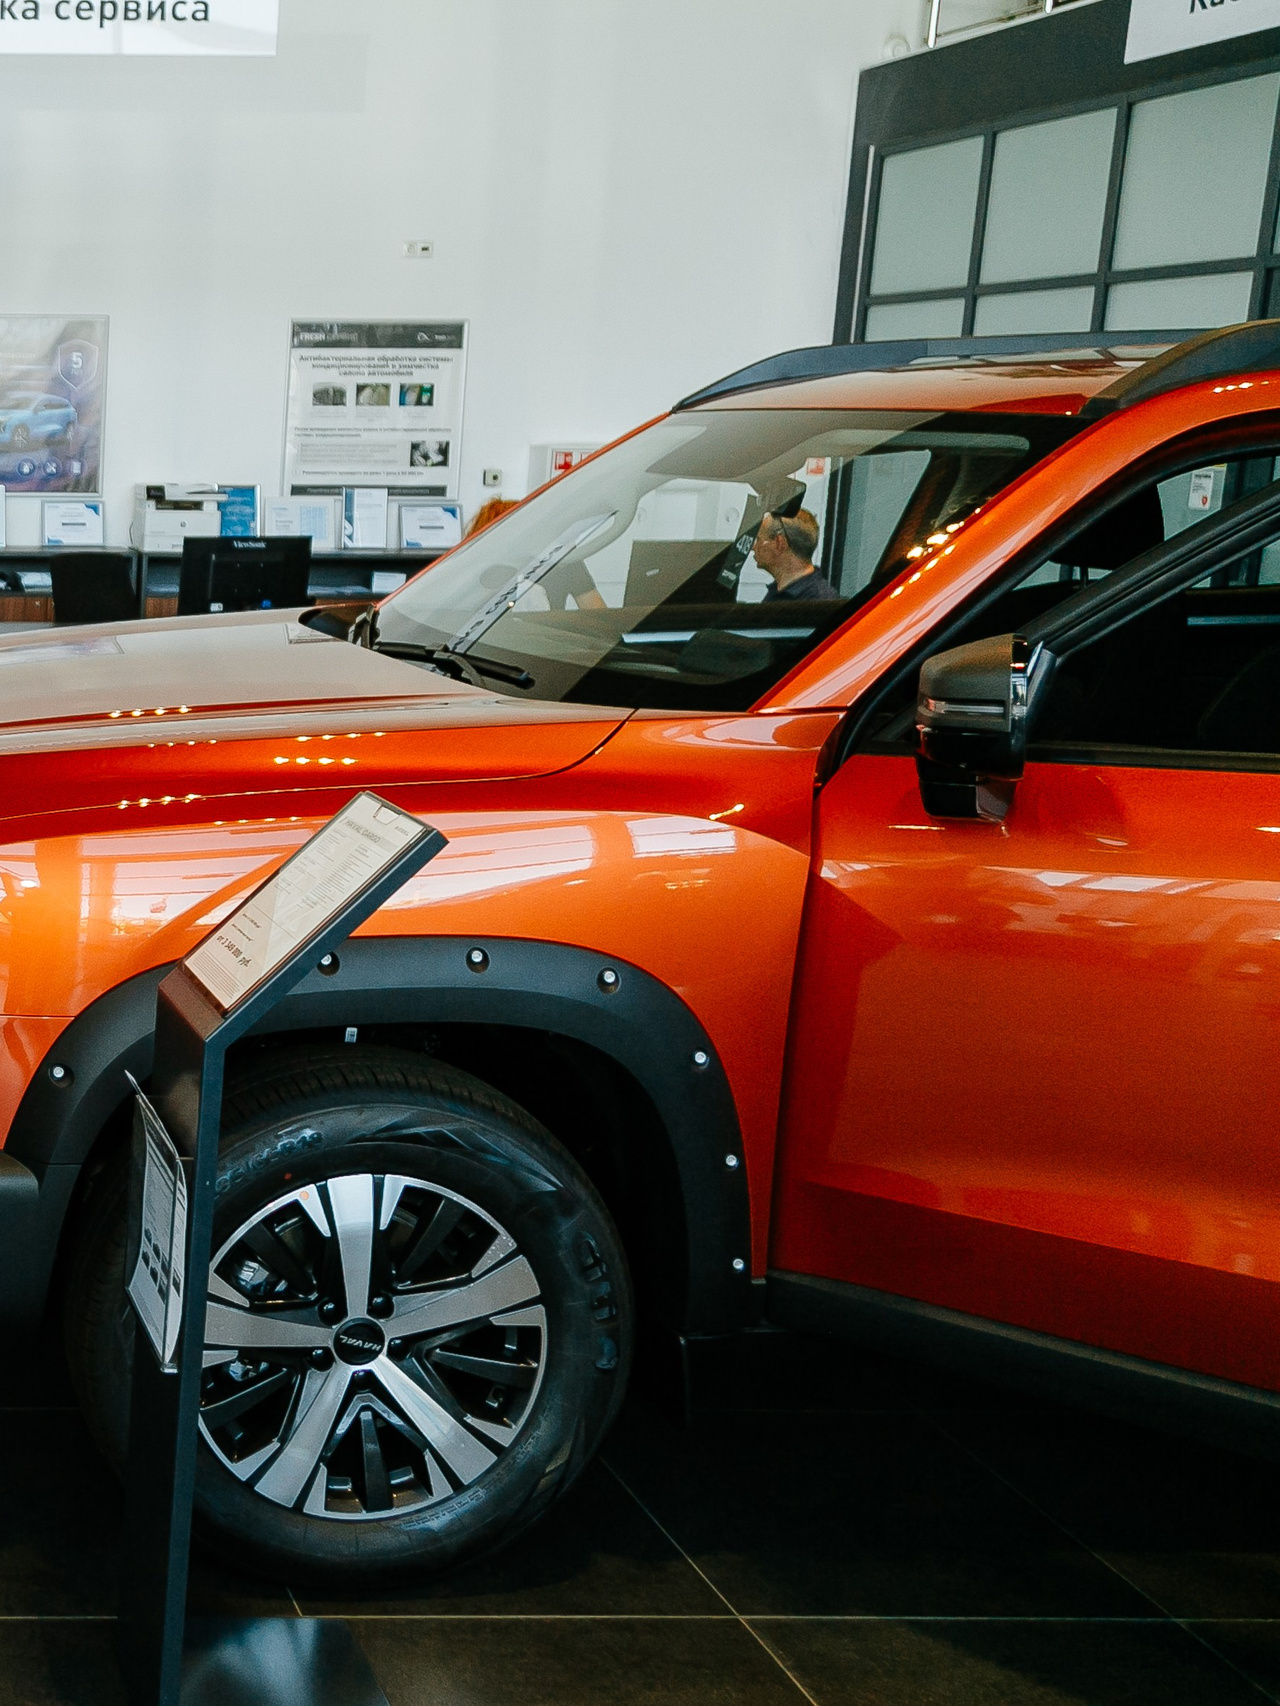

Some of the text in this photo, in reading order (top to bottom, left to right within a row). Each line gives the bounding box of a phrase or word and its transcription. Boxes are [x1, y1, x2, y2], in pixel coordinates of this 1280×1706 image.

[55, 0, 210, 28] сервиса
[72, 352, 82, 368] 5
[339, 1335, 381, 1351] HAVAL
